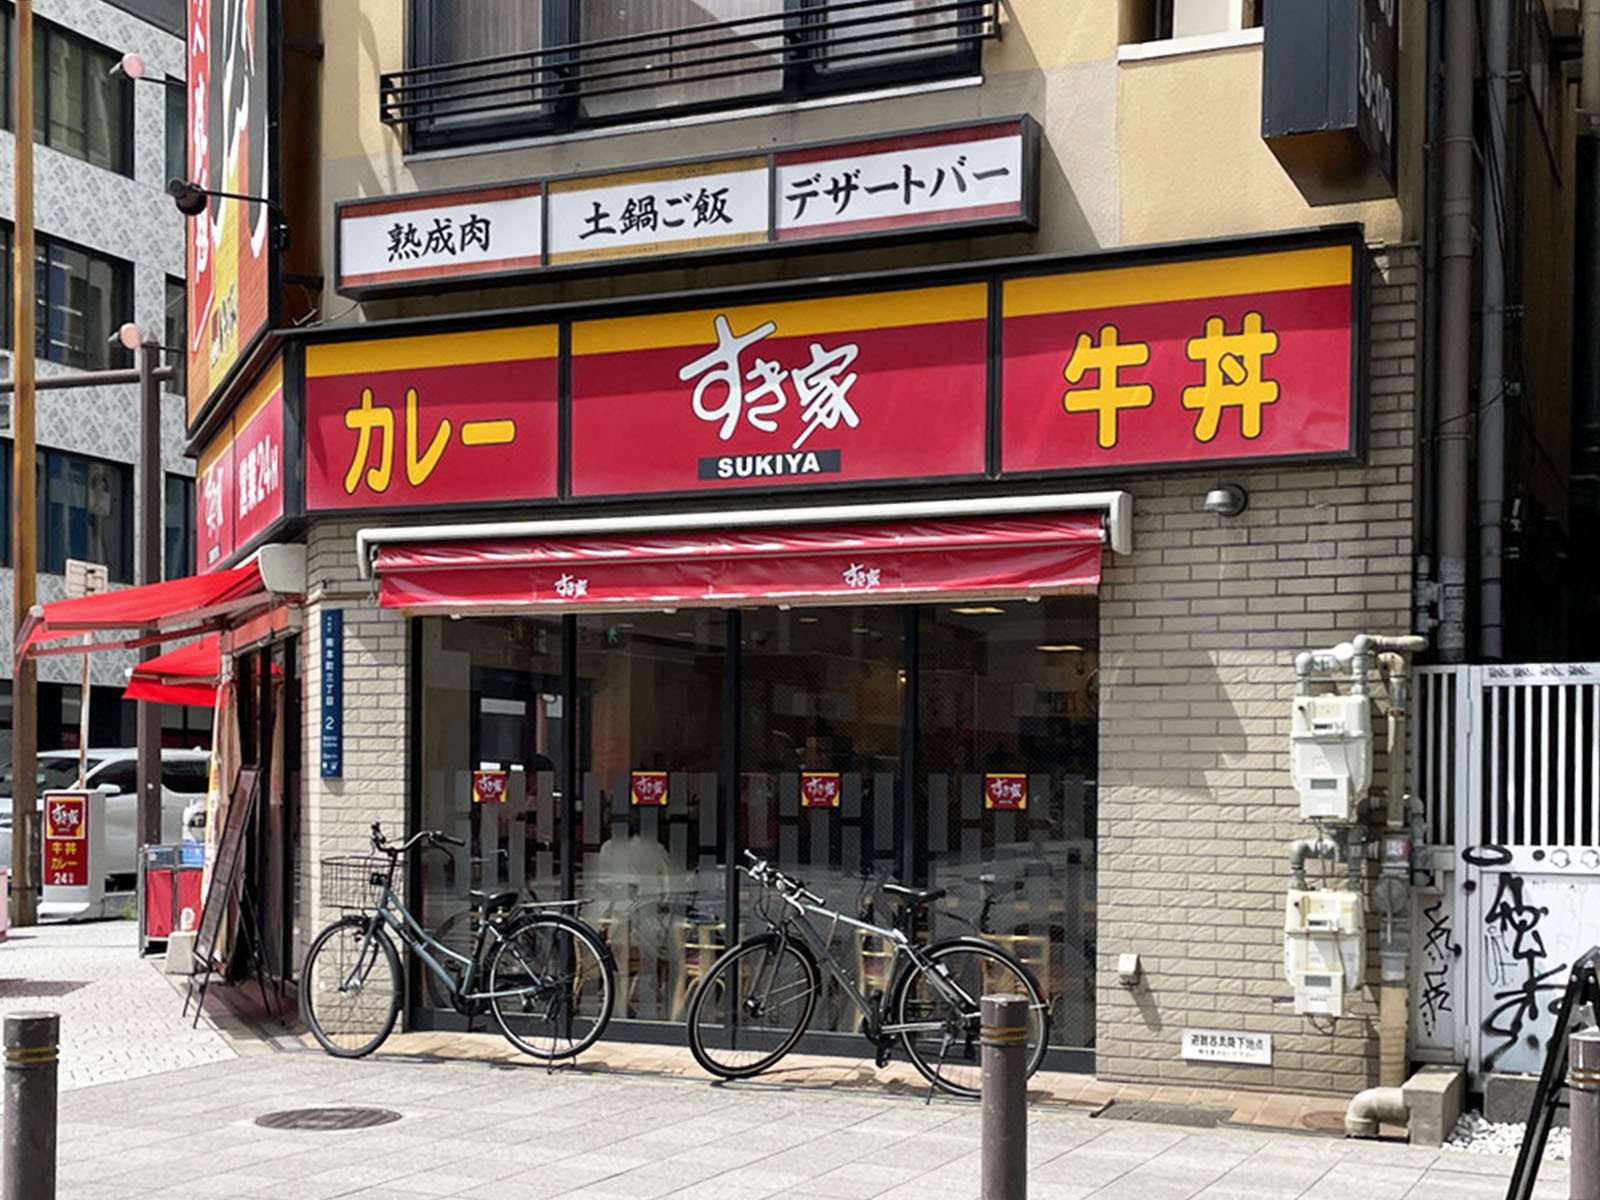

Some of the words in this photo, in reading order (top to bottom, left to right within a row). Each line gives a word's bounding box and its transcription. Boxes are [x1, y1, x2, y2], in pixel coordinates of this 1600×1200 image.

[786, 155, 1010, 221] デザートバー
[578, 187, 734, 240] 土鍋ご飯
[386, 214, 492, 263] 熟成肉
[679, 313, 860, 449] すき家
[1062, 310, 1281, 449] 牛丼
[344, 386, 516, 494] カレー
[717, 452, 820, 478] SUKIYA
[554, 573, 589, 600] すき家
[843, 562, 881, 590] すき家
[325, 716, 335, 730] 2
[50, 857, 78, 871] カレー
[51, 841, 77, 856] 牛丼
